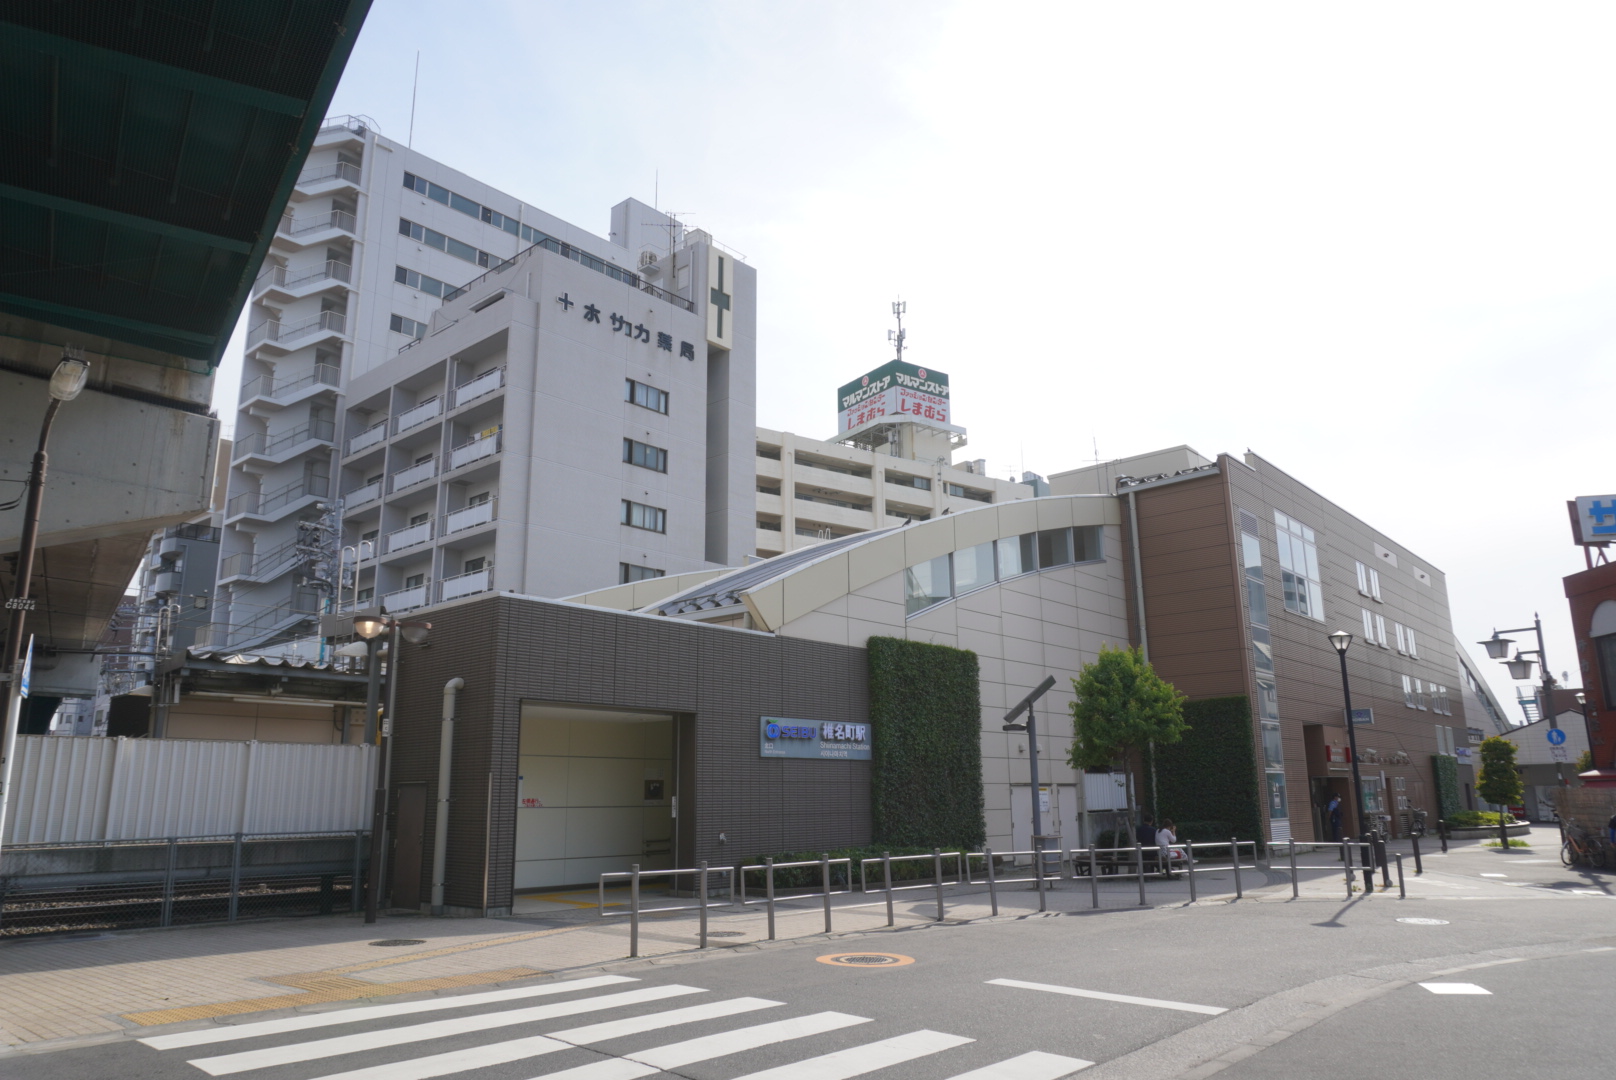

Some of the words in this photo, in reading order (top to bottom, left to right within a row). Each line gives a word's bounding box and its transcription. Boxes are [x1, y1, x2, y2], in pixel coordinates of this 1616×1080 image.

[583, 303, 695, 362] ホサカ薬局
[842, 375, 891, 408] マルマンストア
[895, 372, 949, 396] マルマンストア
[900, 398, 947, 422] しまむら
[5, 601, 35, 610] C8044
[781, 725, 817, 739] SEIBU
[822, 722, 866, 741] 椎名町駅
